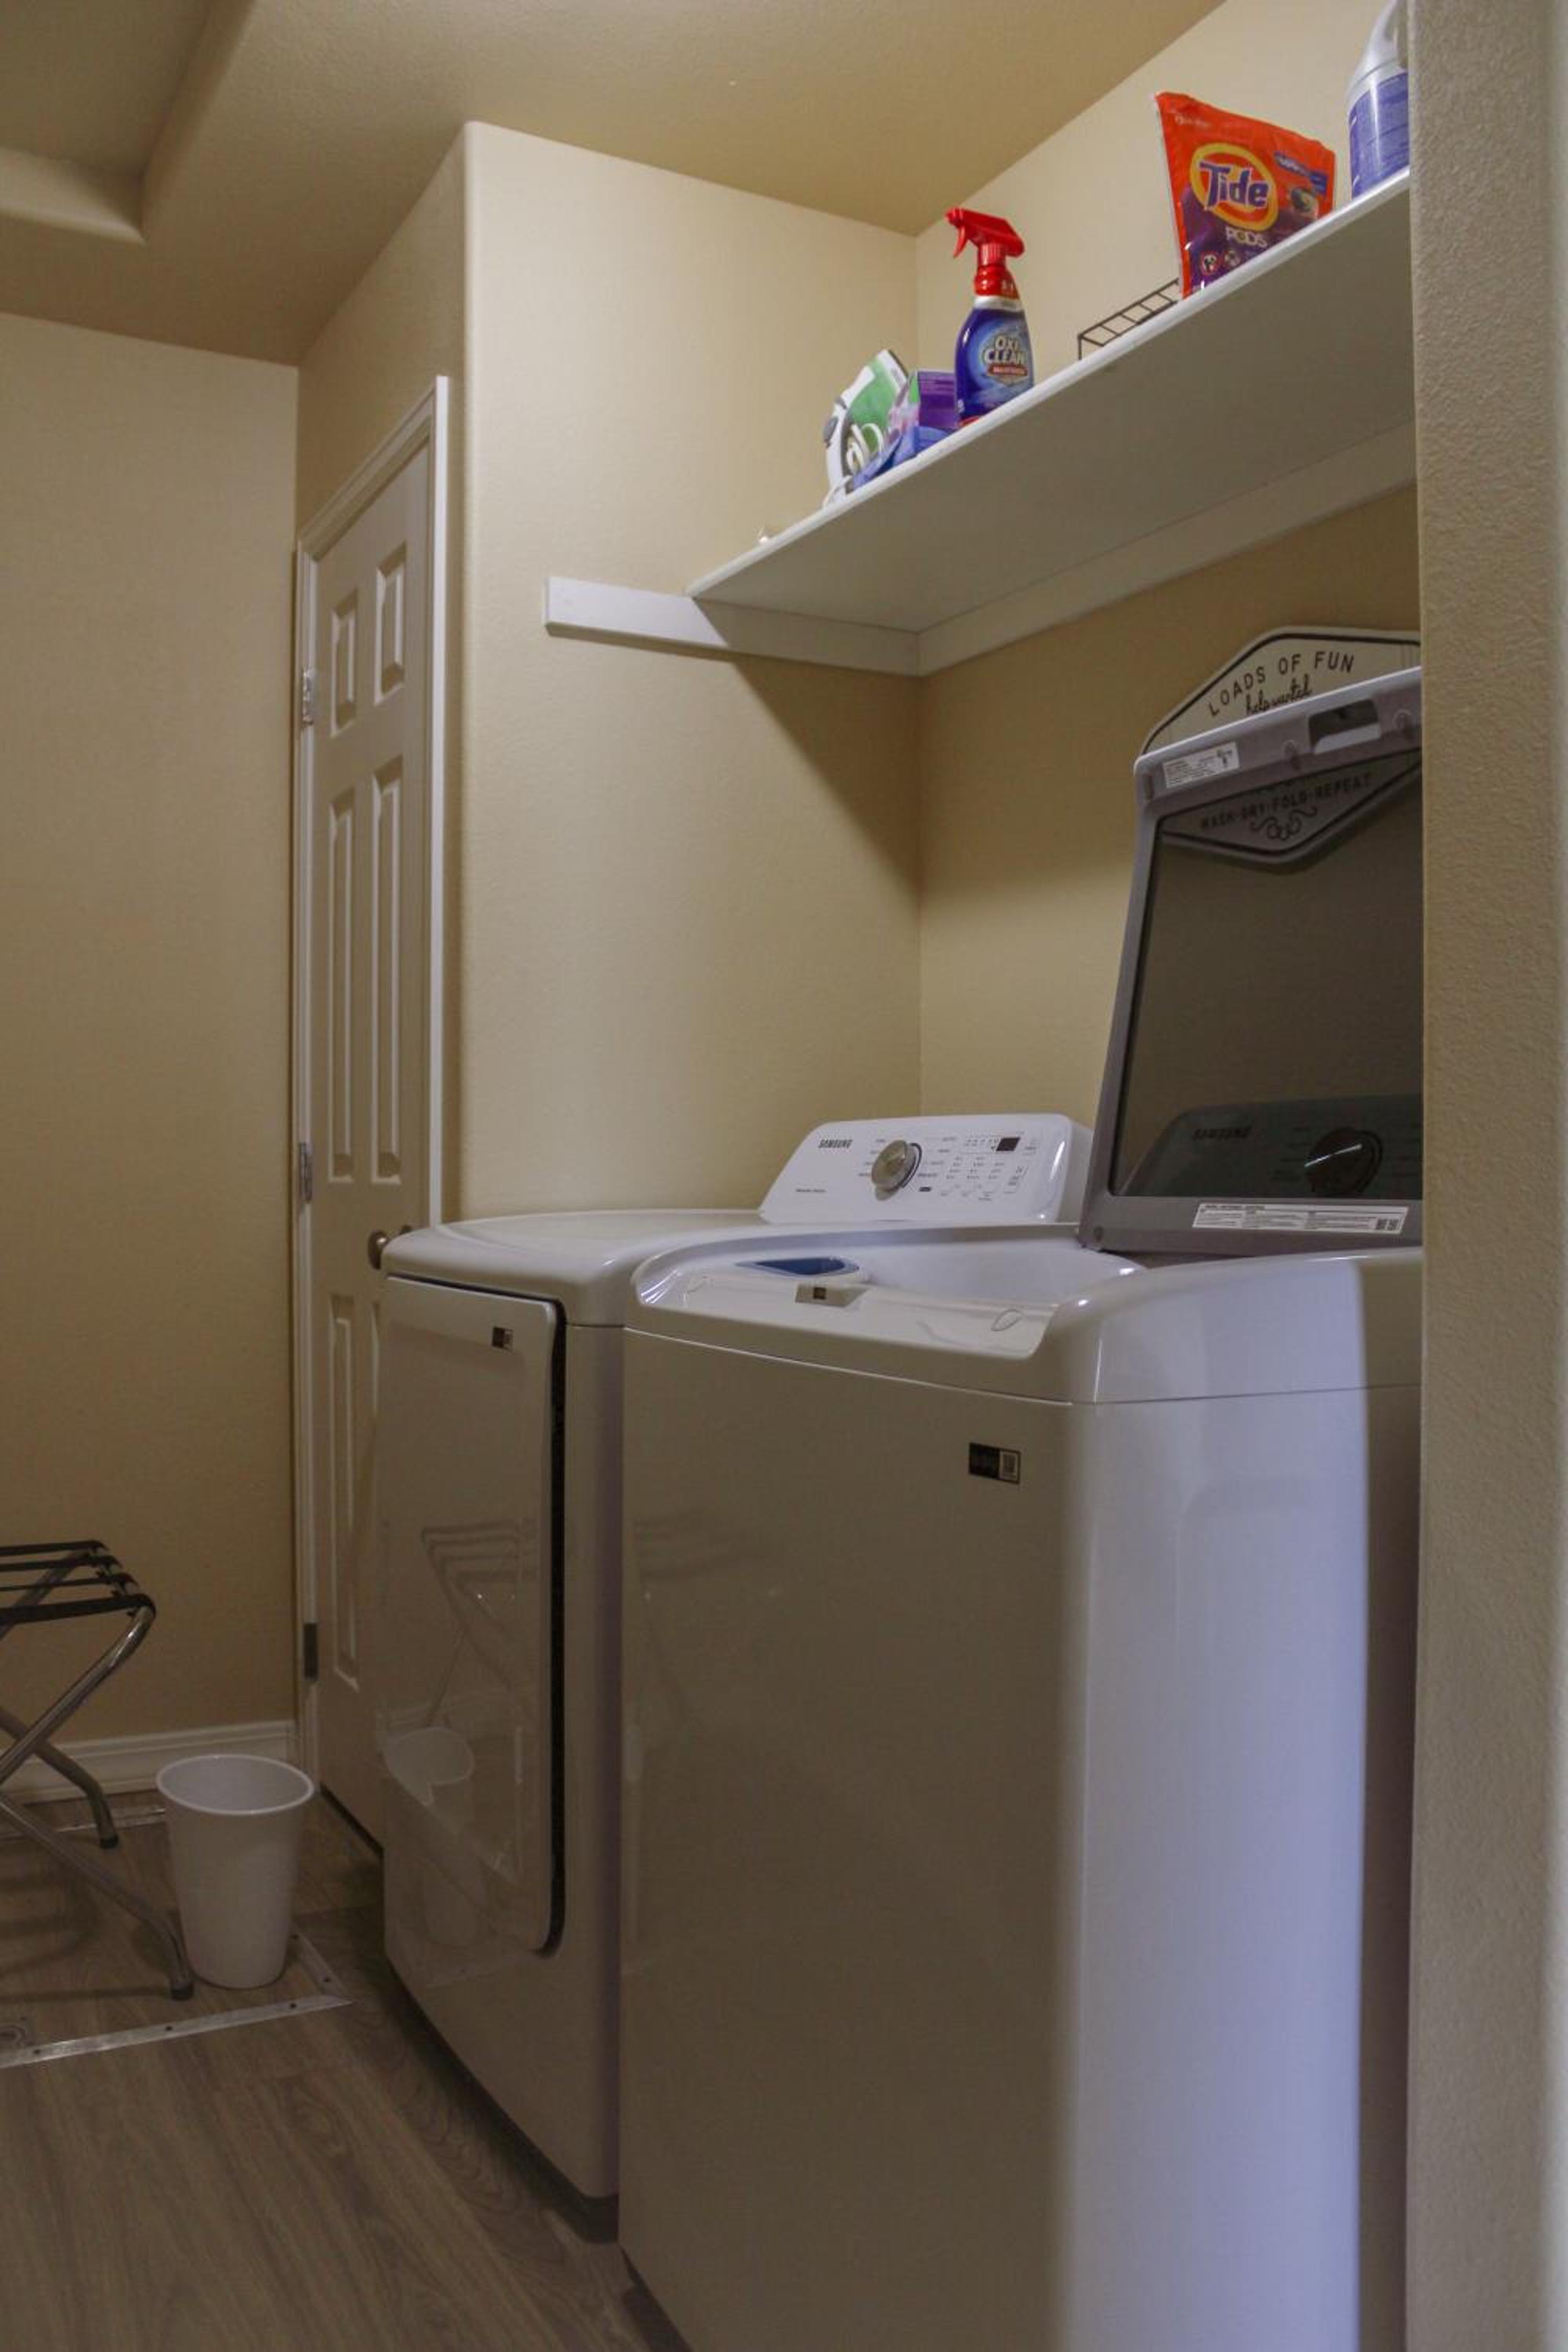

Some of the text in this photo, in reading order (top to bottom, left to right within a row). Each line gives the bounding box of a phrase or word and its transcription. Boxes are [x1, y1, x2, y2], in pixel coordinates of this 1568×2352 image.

[1198, 159, 1270, 210] Tide
[1225, 226, 1268, 248] PODS
[995, 335, 1019, 350] OXI
[984, 348, 1025, 364] CLEAN
[1208, 652, 1354, 716] LOADS OF FUN
[818, 1139, 853, 1149] SAMSUNG
